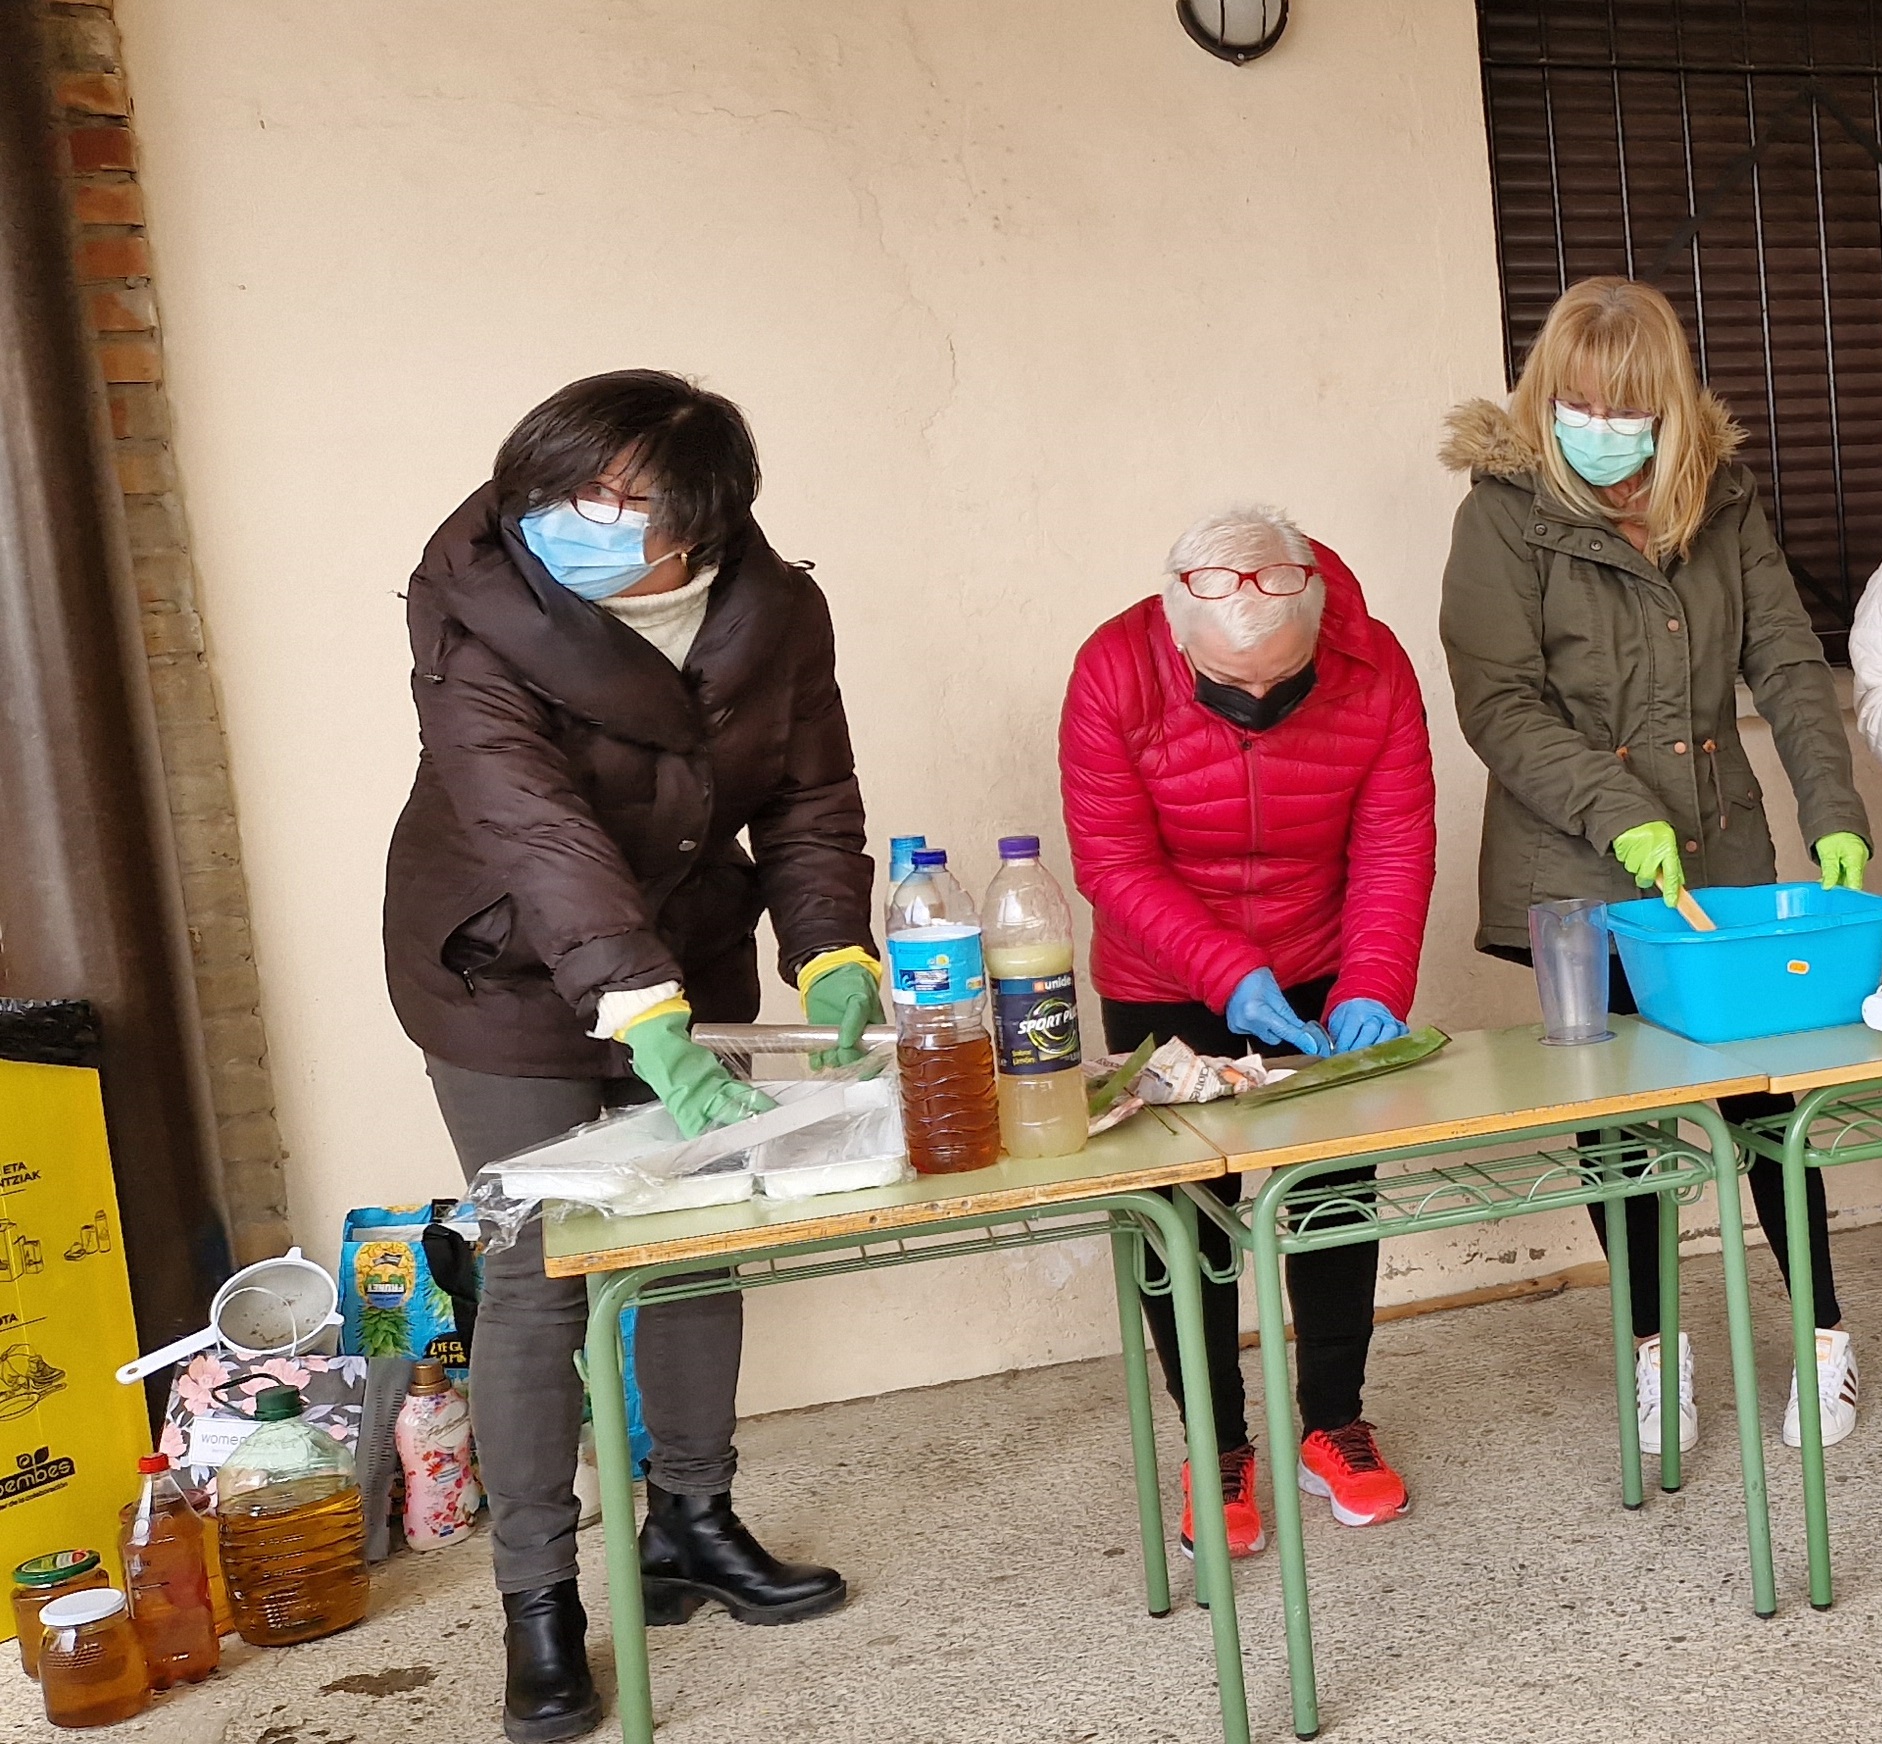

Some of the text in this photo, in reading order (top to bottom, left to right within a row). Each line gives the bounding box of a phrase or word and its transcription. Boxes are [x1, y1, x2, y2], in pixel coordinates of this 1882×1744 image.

[1044, 975, 1072, 990] unide
[1017, 1012, 1063, 1035] SPORT
[3, 1162, 28, 1174] ETA
